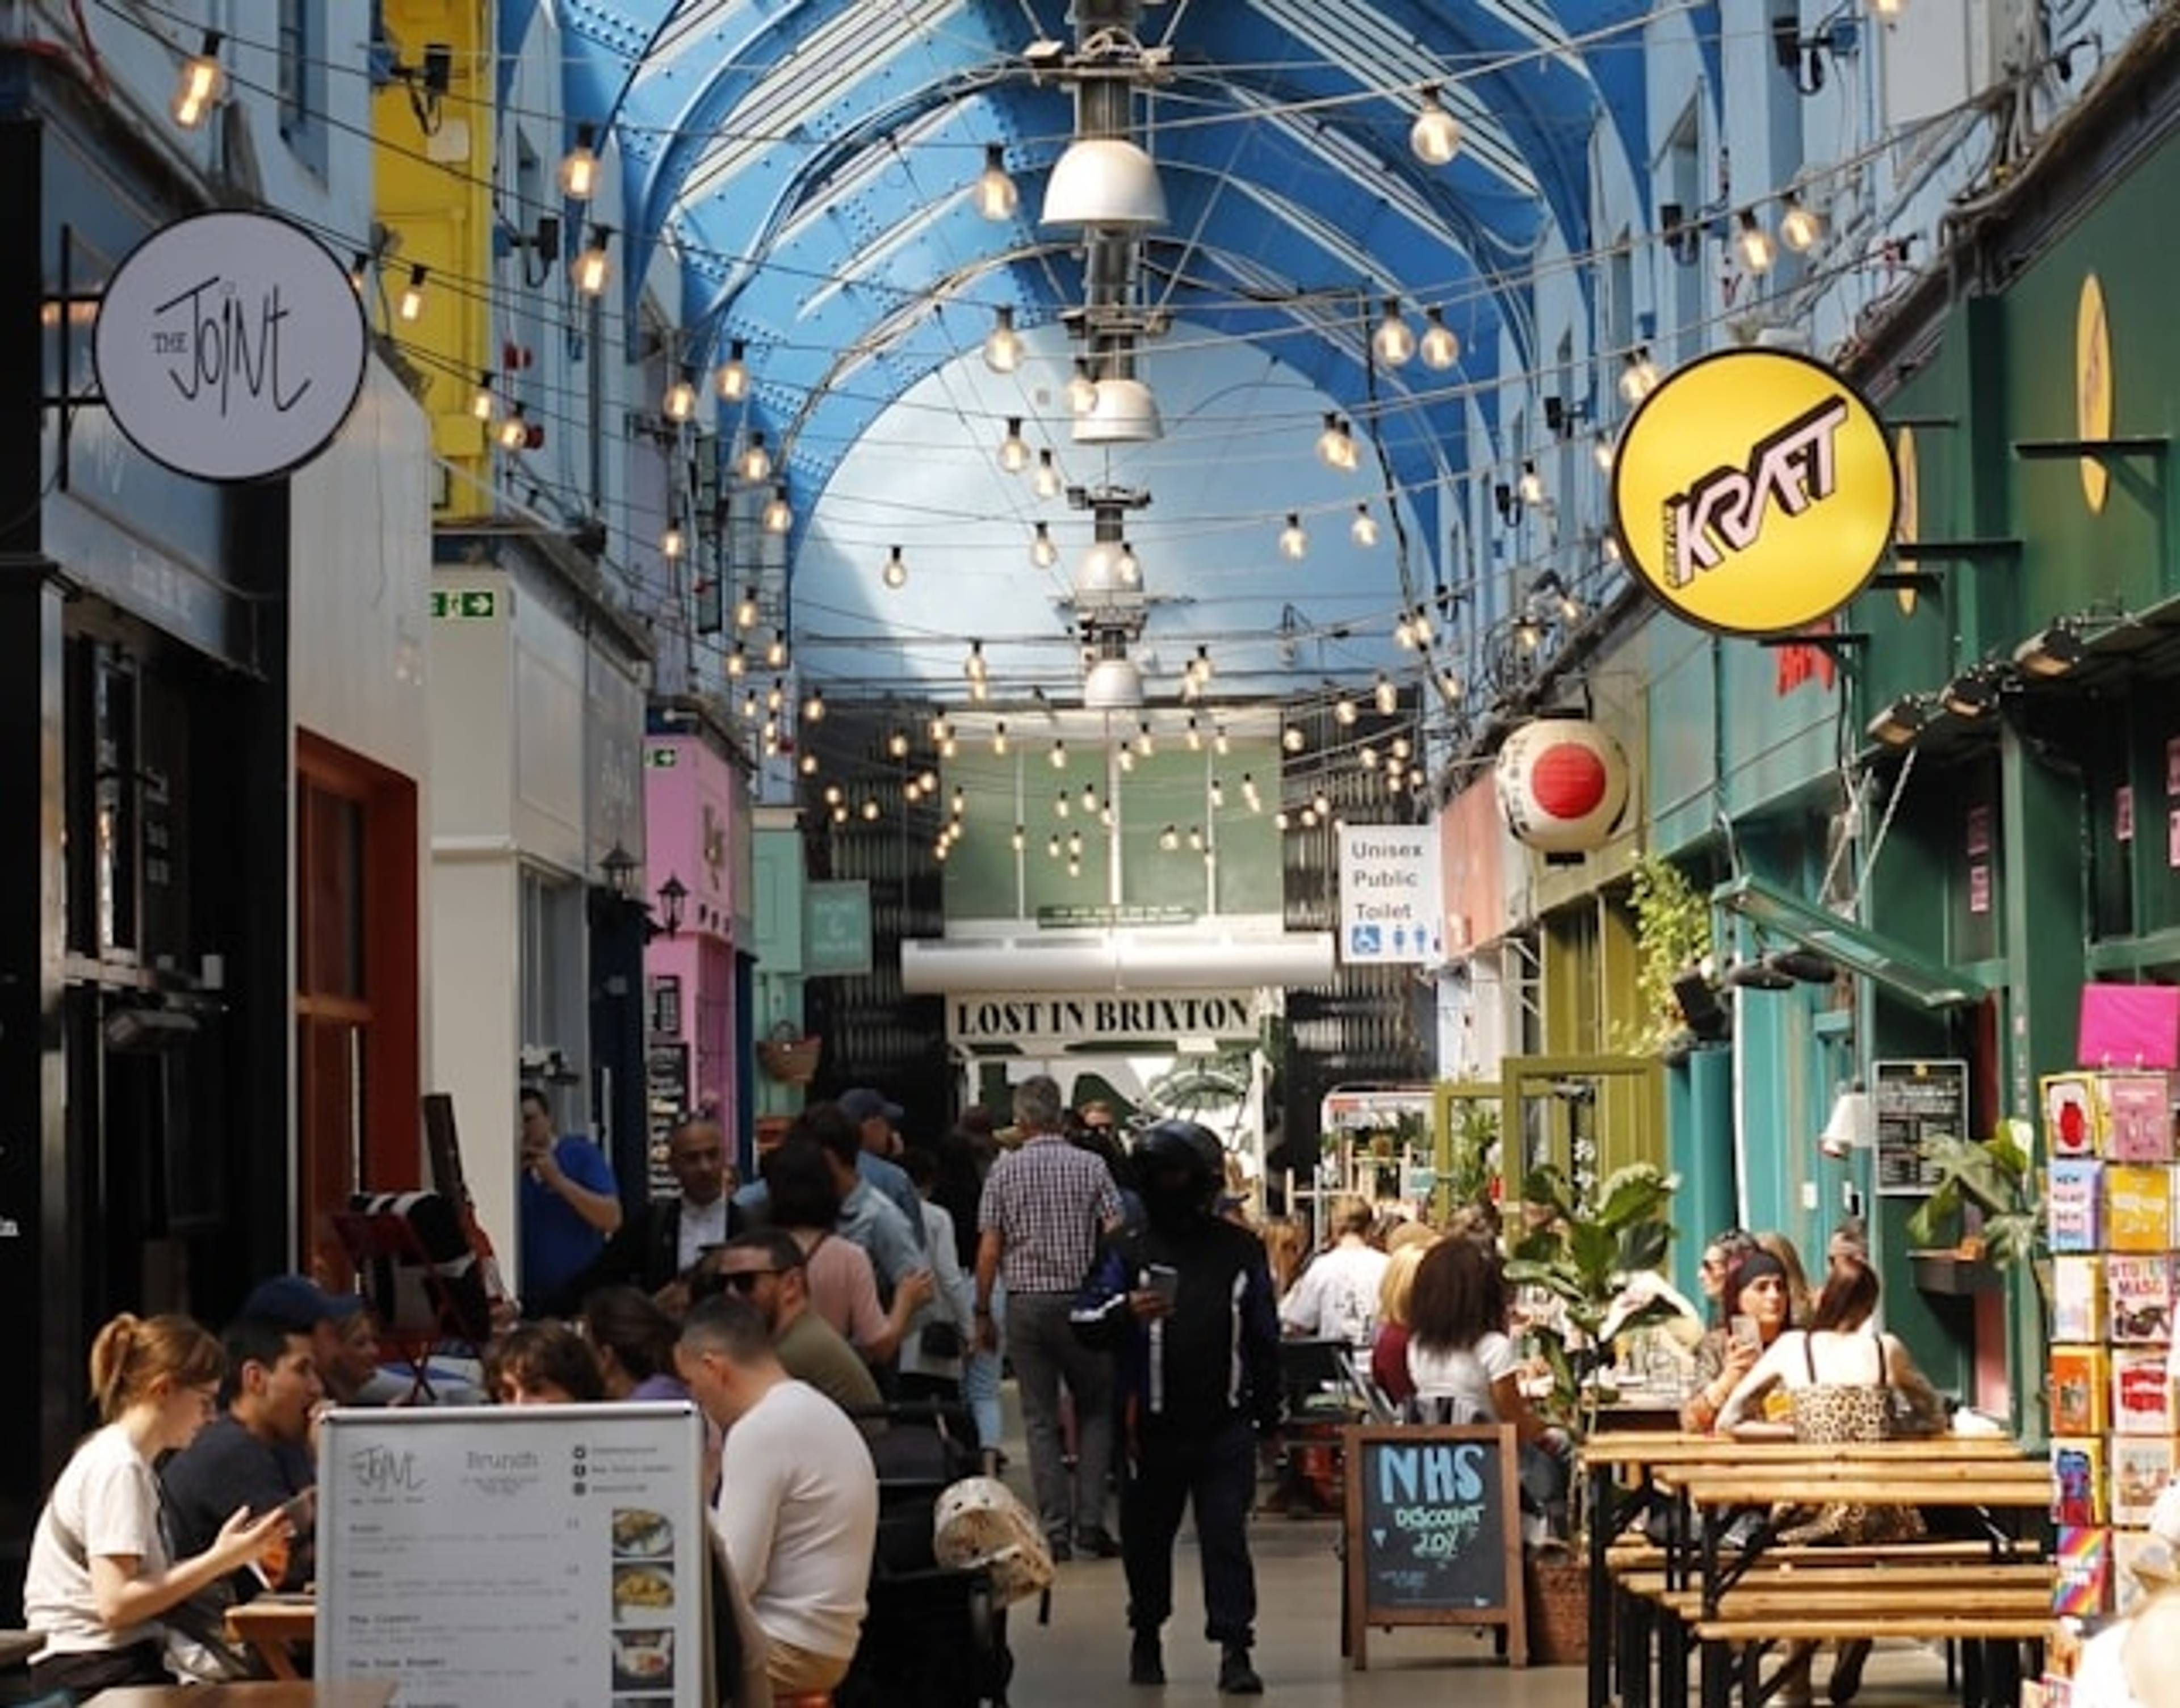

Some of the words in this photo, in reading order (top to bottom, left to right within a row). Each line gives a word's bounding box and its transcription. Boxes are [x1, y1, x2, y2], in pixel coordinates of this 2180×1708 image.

[152, 331, 188, 354] THE
[1665, 393, 1849, 589] KRAFT
[1351, 842, 1423, 860] Unisex
[1353, 870, 1419, 888] Public
[957, 1002, 1041, 1035] LOST
[1053, 1001, 1084, 1034] IN
[1095, 997, 1248, 1033] BRIXTON
[1380, 1445, 1484, 1504] NHS
